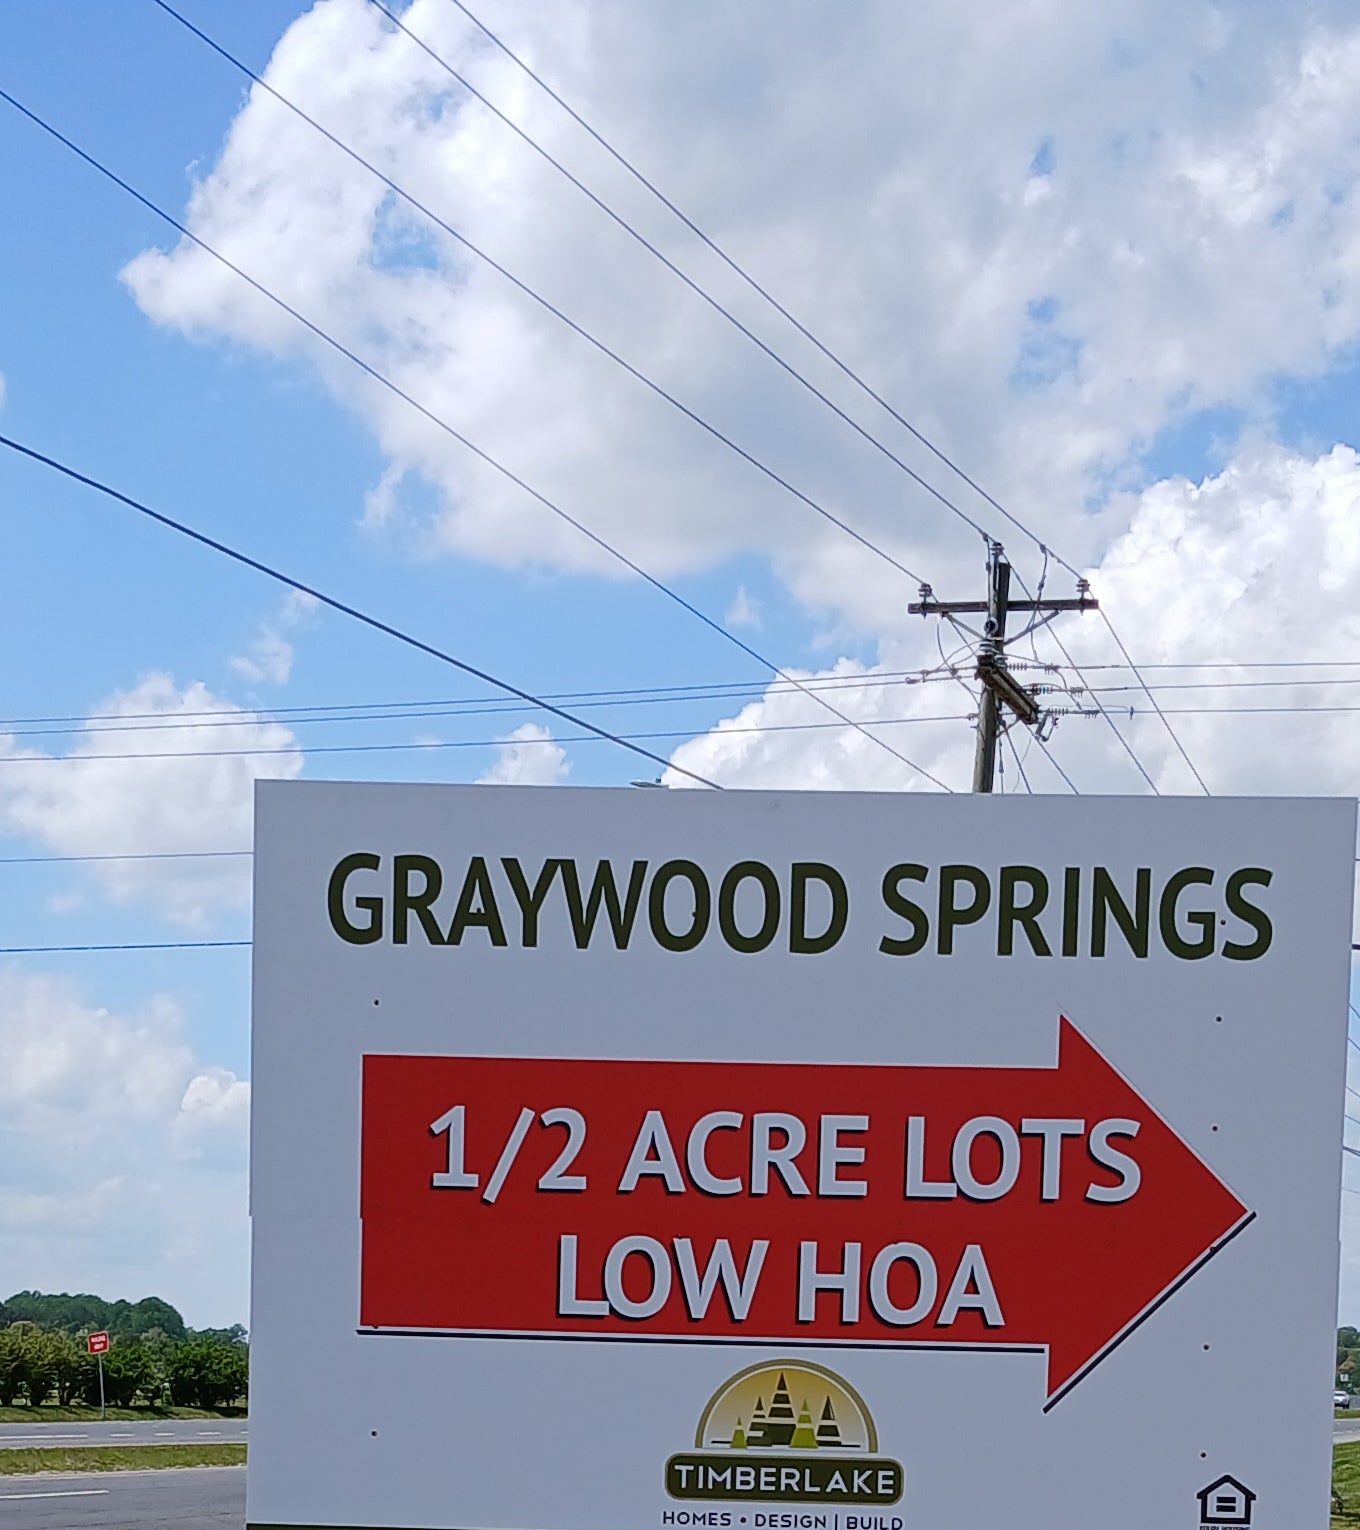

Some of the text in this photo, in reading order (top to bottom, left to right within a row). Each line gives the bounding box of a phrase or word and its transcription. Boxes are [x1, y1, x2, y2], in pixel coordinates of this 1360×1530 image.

[327, 852, 1274, 961] GRAYWOOD SPRINGS
[429, 1105, 1141, 1203] 1/2 ACRE LOTS
[557, 1234, 1006, 1327] LOW HOA
[662, 1511, 904, 1530] HOMES DESIGN BUILD
[674, 1464, 895, 1495] TIMBERLAKE
